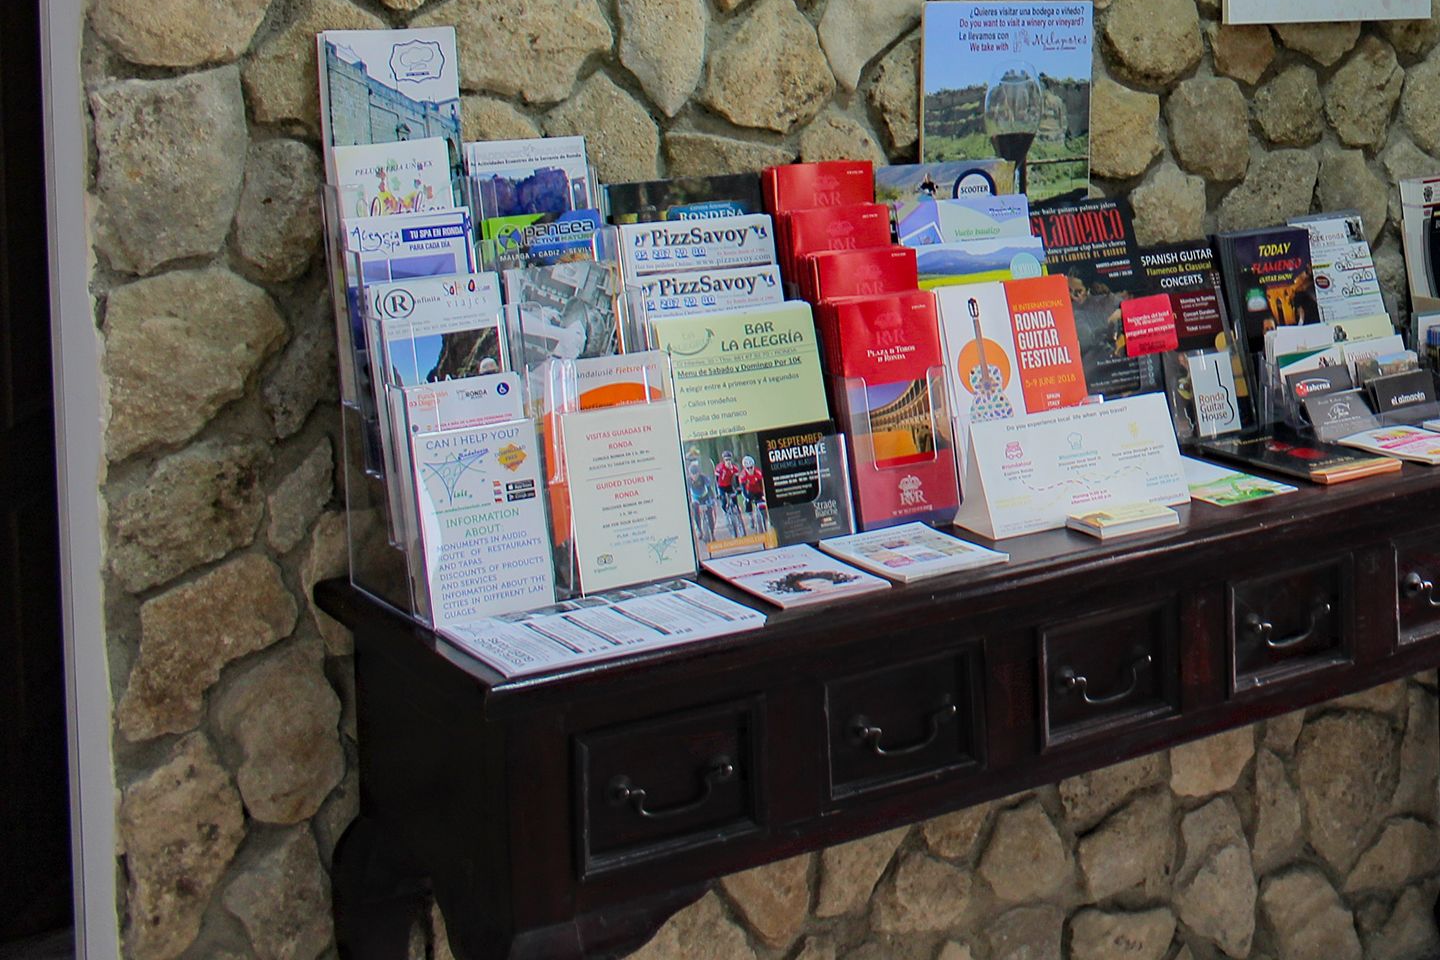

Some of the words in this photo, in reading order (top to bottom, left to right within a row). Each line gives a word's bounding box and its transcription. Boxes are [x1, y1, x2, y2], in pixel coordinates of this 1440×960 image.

[969, 7, 998, 19] ¿Quieres
[999, 6, 1019, 16] visitar
[1032, 6, 1055, 18] bodega
[983, 20, 998, 28] want
[1007, 18, 1020, 27] visit
[1026, 19, 1046, 29] winery
[1055, 18, 1085, 28] vineyard?
[968, 31, 996, 40] llevamos
[981, 43, 995, 51] take
[996, 42, 1009, 51] with
[960, 184, 988, 194] SCOOTER
[419, 229, 432, 238] SPA
[651, 227, 748, 248] PizzSavoy
[1259, 242, 1291, 258] TODAY
[1140, 252, 1178, 267] SPANISH
[1179, 248, 1213, 262] GUITAR
[1146, 267, 1178, 277] Flamenco
[1185, 261, 1212, 271] Classical
[658, 274, 757, 295] PizzSavoy
[1160, 274, 1203, 288] CONCERTS
[1014, 310, 1055, 331] RONDA
[744, 321, 774, 335] BAR
[721, 340, 739, 352] LA
[743, 331, 804, 349] ALEGRÍA
[1017, 328, 1060, 350] GUITAR
[1020, 346, 1072, 370] FESTIVAL
[677, 370, 697, 379] Menu
[740, 360, 773, 371] Domingo
[774, 358, 787, 367] Por
[1199, 392, 1225, 404] Ronda
[1200, 402, 1225, 414] Guitar
[1201, 412, 1228, 423] House
[426, 440, 450, 450] CAN
[453, 438, 457, 446] I
[460, 433, 488, 444] HELP
[491, 427, 520, 440] YOU?
[585, 430, 610, 441] VISITAS
[608, 441, 633, 450] RONDA
[596, 480, 622, 490] GUIDED
[623, 476, 645, 486] TOURS
[614, 490, 639, 500] RONDA
[446, 508, 520, 528] INFORMATION
[499, 530, 527, 541] AUDIO
[487, 538, 542, 552] RESTAURANTS
[439, 562, 457, 572] AND
[459, 559, 483, 569] TAPAS
[440, 567, 487, 581] DISCOUNTS
[502, 556, 544, 570] PRODUCTS
[441, 581, 459, 591] AND
[461, 574, 497, 587] SERVICES
[442, 584, 498, 600] INFORMATION
[501, 578, 528, 589] ABOUT
[530, 575, 545, 583] THE
[443, 598, 469, 610] CITIES
[483, 588, 524, 602] DIFFERENT
[444, 608, 476, 619] GUAGES
